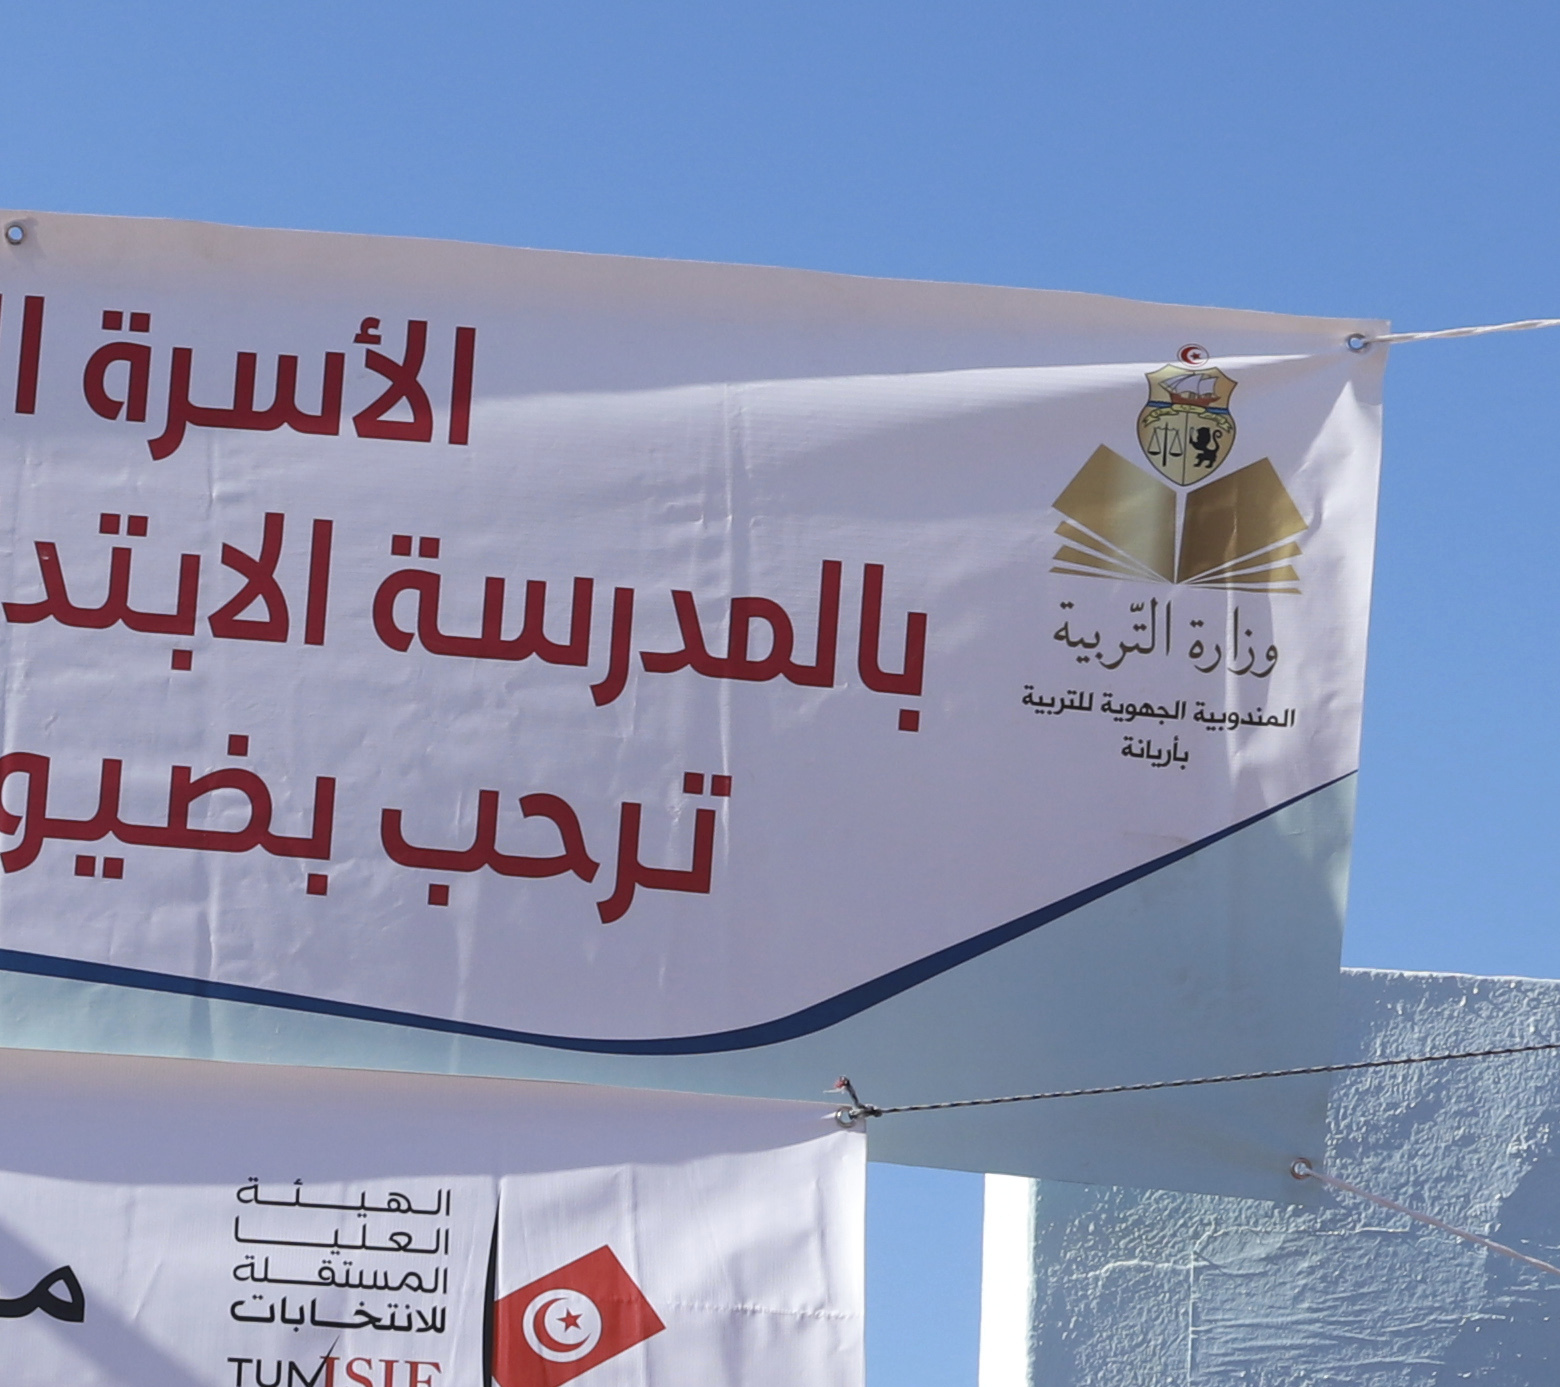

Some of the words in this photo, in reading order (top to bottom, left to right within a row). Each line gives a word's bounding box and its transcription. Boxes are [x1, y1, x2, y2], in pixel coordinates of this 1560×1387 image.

[84, 312, 476, 461] الأسرة
[375, 536, 927, 733] بالمدرسة
[1187, 606, 1279, 679] وزارة
[1021, 684, 1094, 716] للتربية
[1100, 692, 1187, 725] الجهوية
[1192, 700, 1296, 732] المندوبية
[1120, 735, 1190, 771] بأريانة
[382, 773, 732, 923] ترحب
[230, 1294, 447, 1334] للانتخابات
